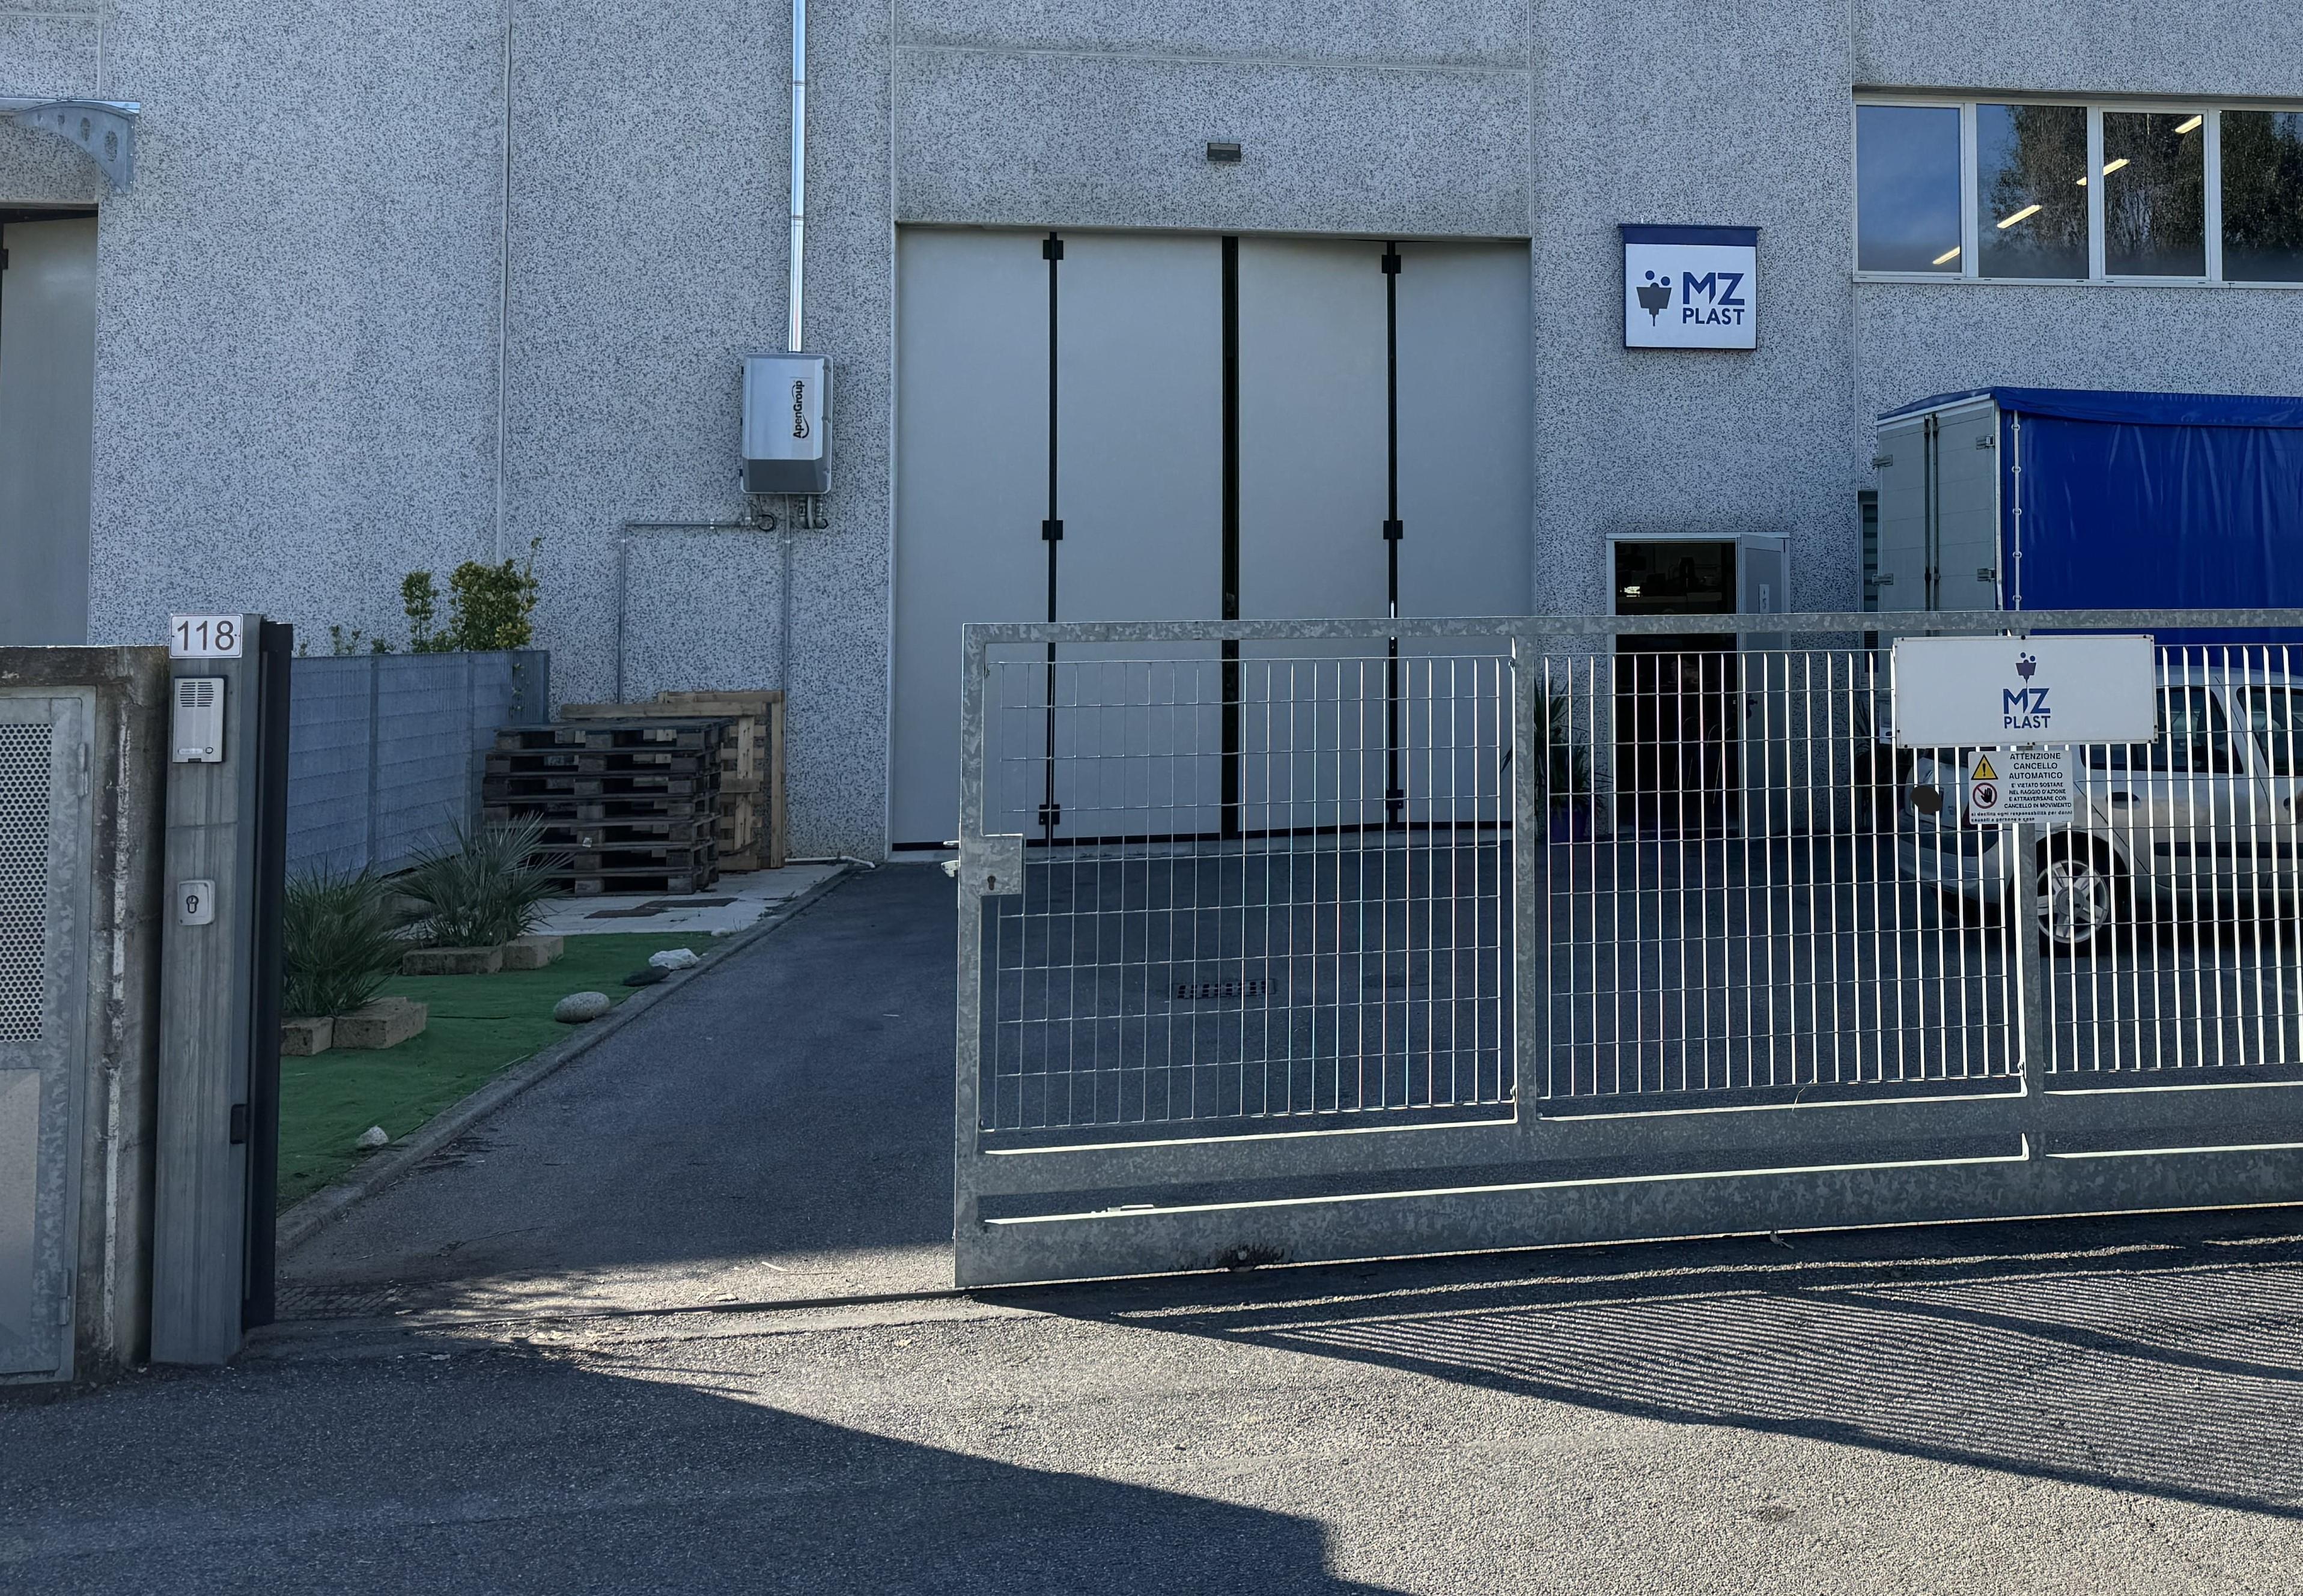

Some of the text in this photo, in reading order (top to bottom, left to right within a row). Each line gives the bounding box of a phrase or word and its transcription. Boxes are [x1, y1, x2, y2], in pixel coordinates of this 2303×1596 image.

[1682, 272, 1745, 306] MZ
[1682, 308, 1745, 325] PLAST
[793, 380, 805, 438] ApenGroup
[177, 620, 234, 651] 118
[2003, 688, 2051, 714] MZ
[2004, 715, 2051, 729] PLAST
